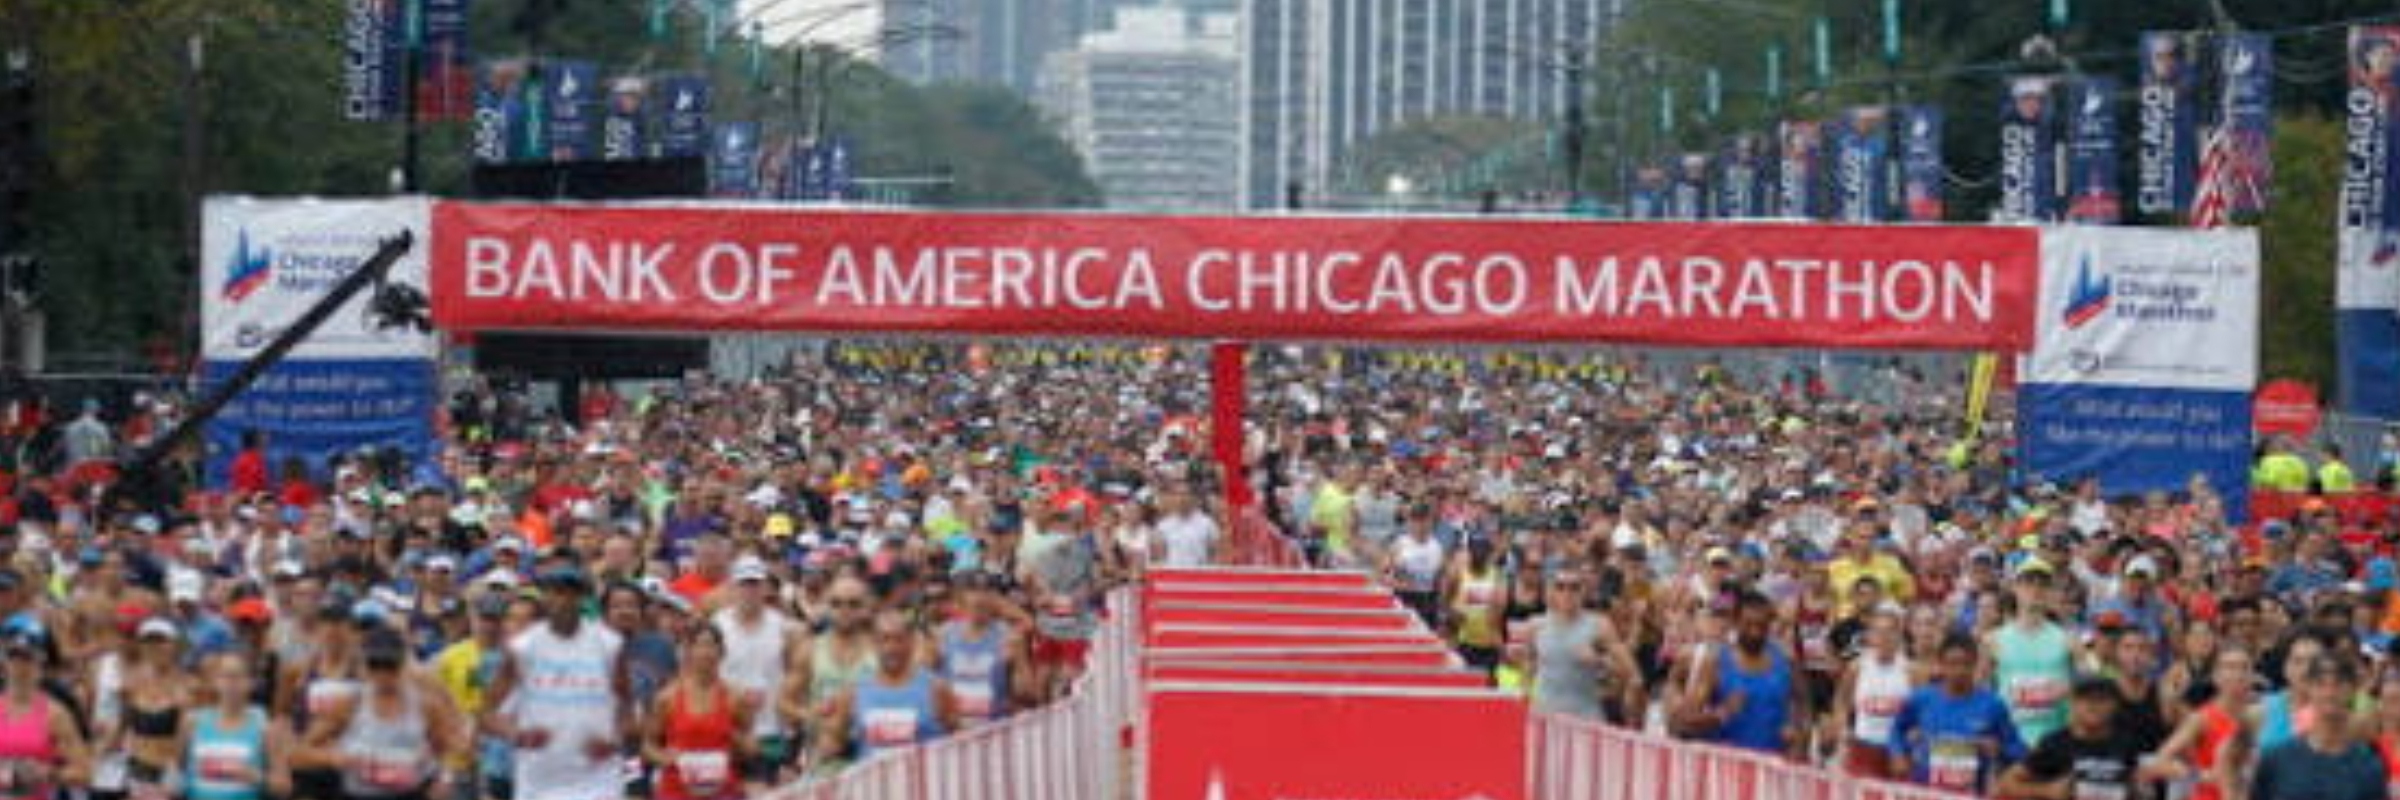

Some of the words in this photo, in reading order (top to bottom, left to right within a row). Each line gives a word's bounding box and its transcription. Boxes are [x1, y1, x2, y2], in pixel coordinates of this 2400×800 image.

[2138, 85, 2163, 214] CHICAGO
[2347, 86, 2375, 229] CHICAGO
[465, 236, 675, 305] BANK
[697, 241, 799, 307] OF
[813, 245, 1165, 311] AMERICA
[1186, 248, 1529, 319] CHICAGO
[1554, 254, 1996, 323] MARATHON
